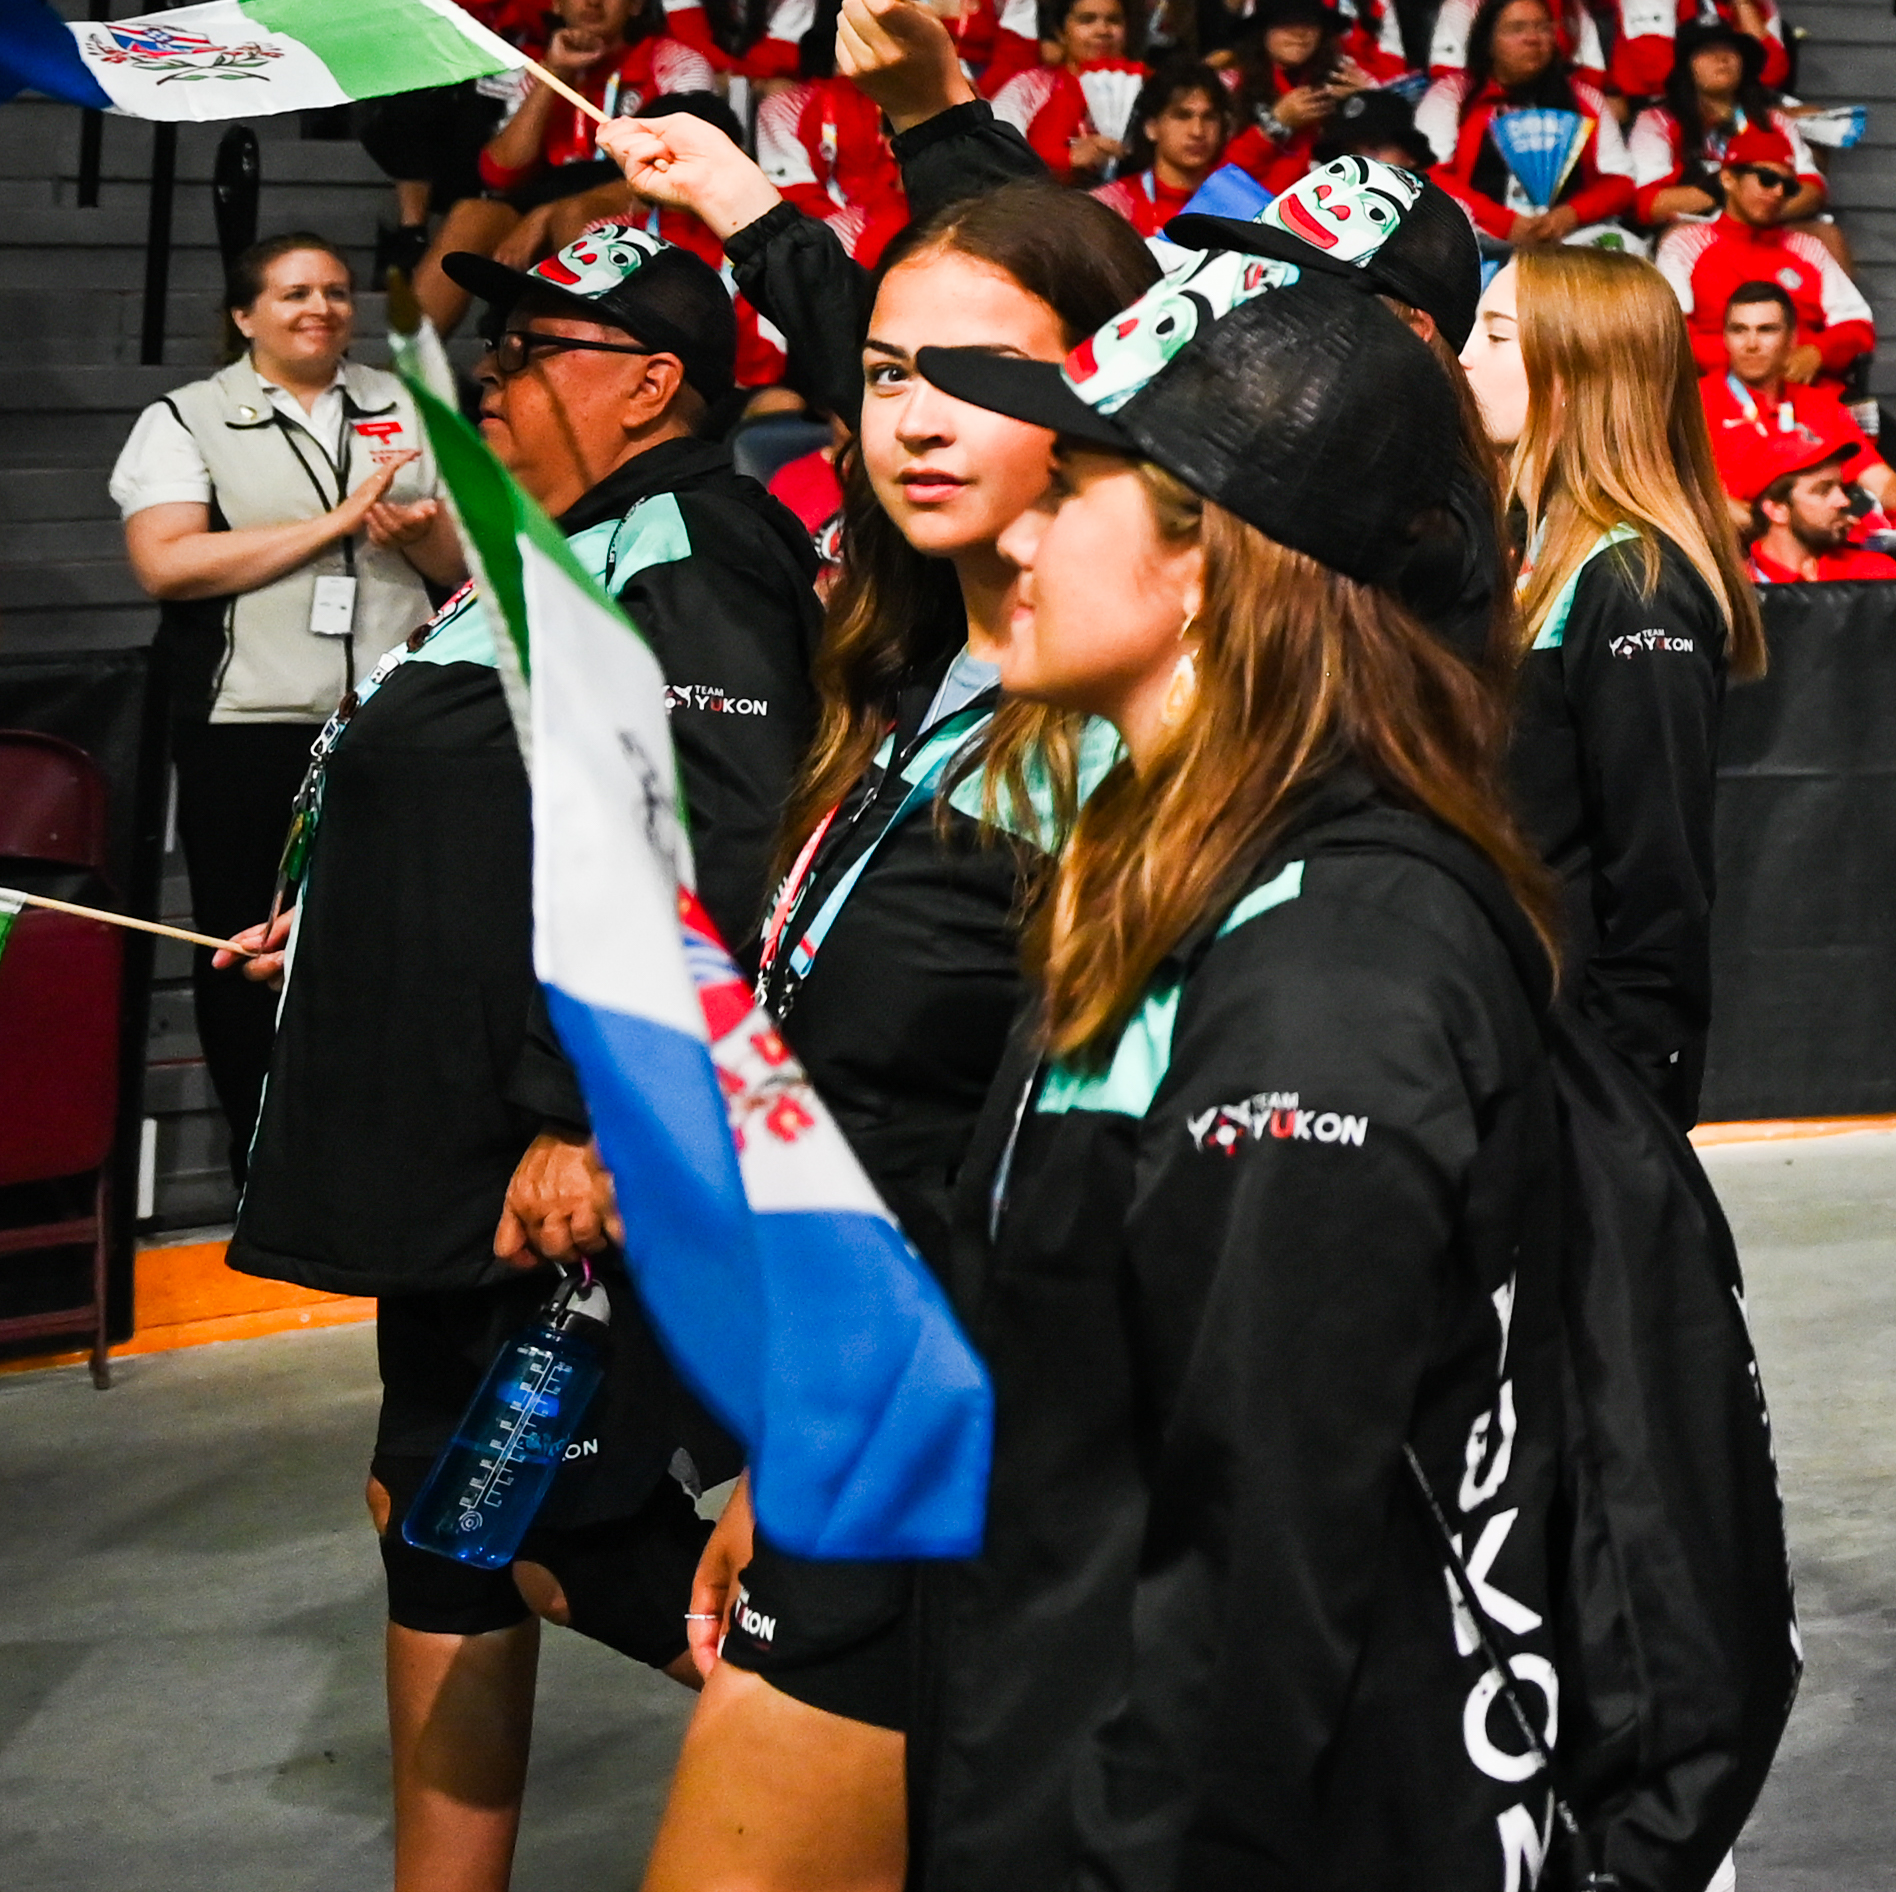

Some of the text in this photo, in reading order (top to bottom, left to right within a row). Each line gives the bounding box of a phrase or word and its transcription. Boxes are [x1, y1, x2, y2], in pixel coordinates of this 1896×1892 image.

[1641, 628, 1666, 638] TEAM
[1643, 636, 1694, 653] YUKON
[694, 684, 725, 697] TEAM
[694, 694, 769, 717] YUKON
[1251, 1108, 1369, 1147] YUKON
